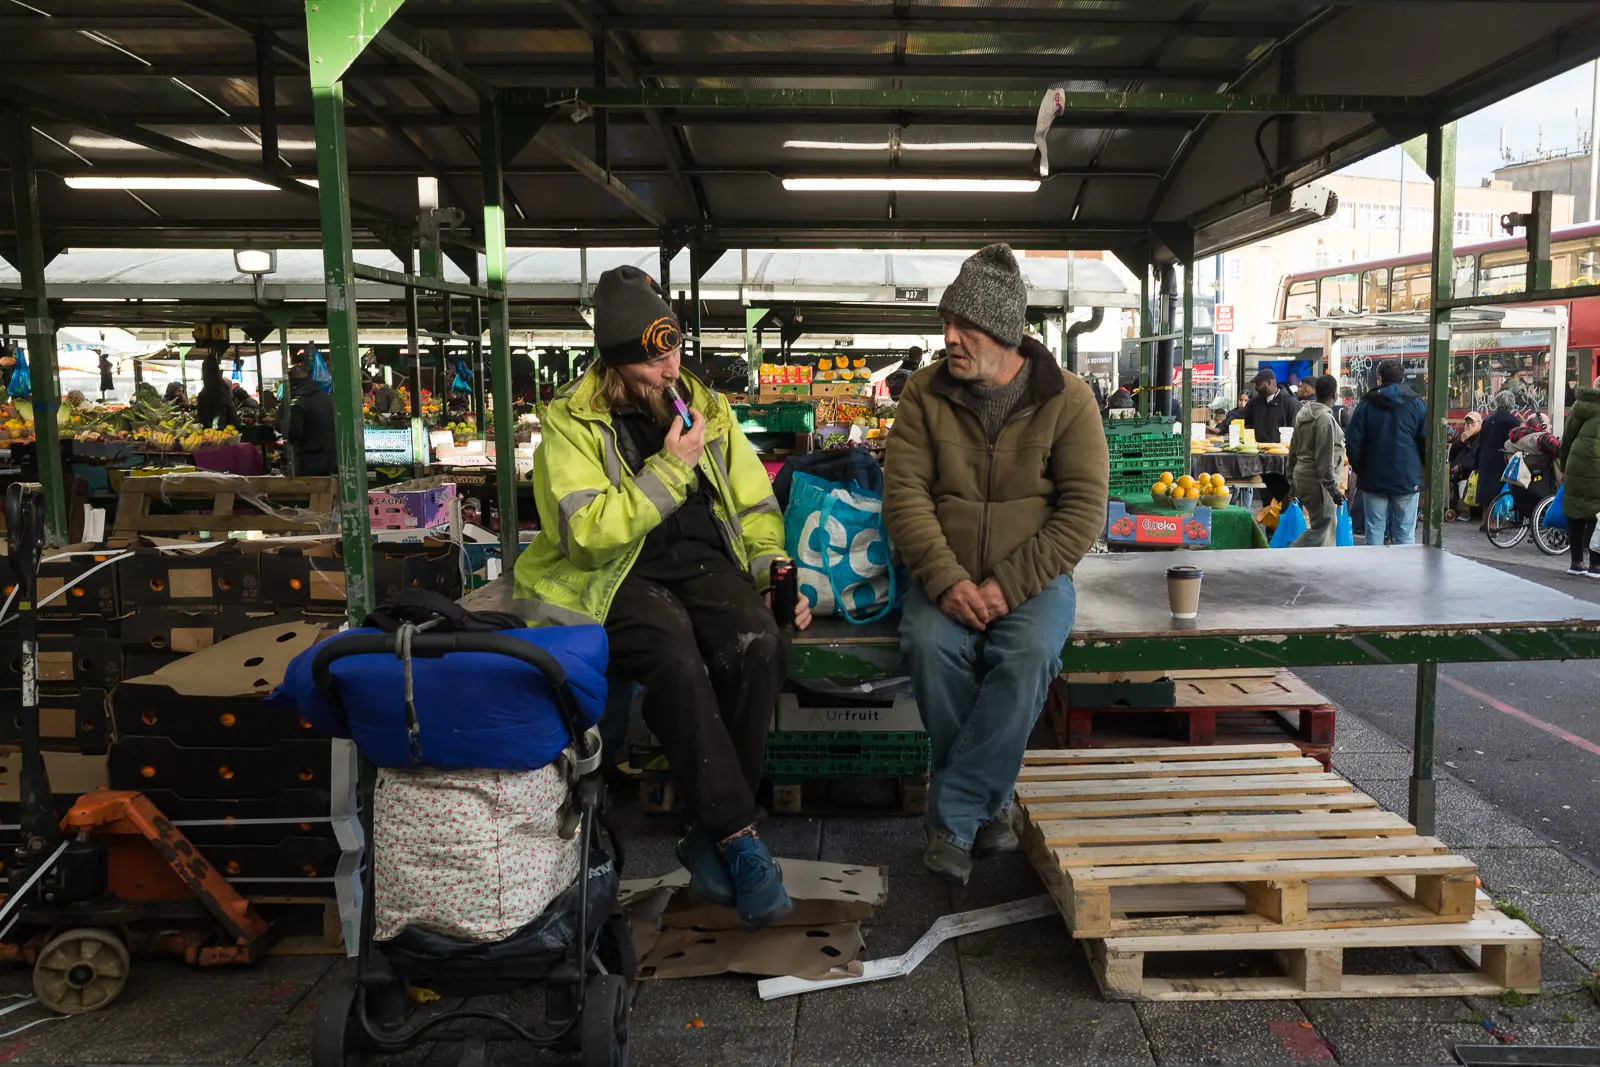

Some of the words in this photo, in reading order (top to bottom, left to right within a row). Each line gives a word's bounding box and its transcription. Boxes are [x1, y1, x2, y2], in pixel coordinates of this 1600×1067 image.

[905, 291, 918, 299] B27
[1142, 519, 1177, 531] Eureka
[826, 710, 880, 721] Urfruit
